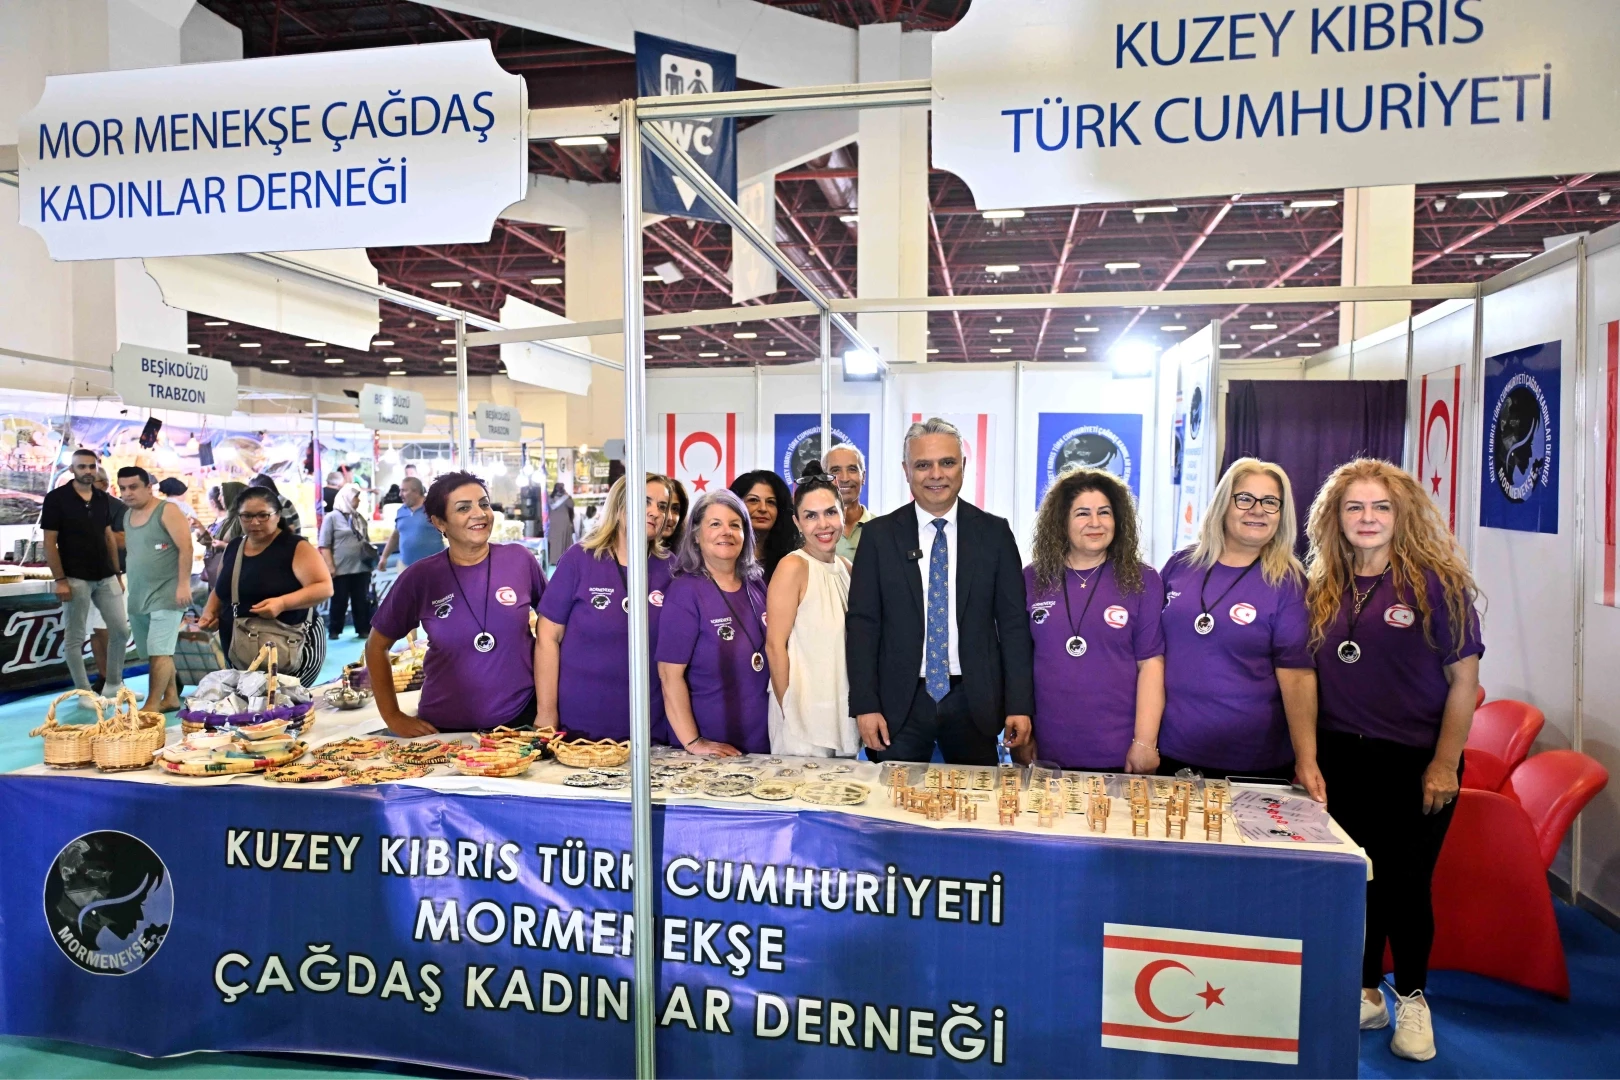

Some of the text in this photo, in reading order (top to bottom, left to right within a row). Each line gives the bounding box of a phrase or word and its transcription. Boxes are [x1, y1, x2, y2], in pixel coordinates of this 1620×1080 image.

[1115, 0, 1485, 69] KUZEY KIBRIS
[39, 88, 496, 161] MOR MENEKŞE ÇAĞDAŞ
[1000, 62, 1553, 153] TÜRK CUMHURİYETİ
[660, 120, 714, 156] WC
[40, 156, 408, 222] KADINLAR DERNEĞİ
[141, 357, 209, 382] BEŞİKDÜZÜ
[148, 383, 207, 405] TRABZON
[374, 393, 411, 409] BEDÜZÜ
[1497, 467, 1539, 500] MORMENEKŞE
[226, 829, 362, 871] KUZEY
[381, 837, 520, 882] KIBRIS
[666, 857, 1002, 924] CUMHURİYETİ
[57, 925, 152, 970] MORMENEKŞE
[214, 944, 1005, 1064] ÇAĞDAŞ KADINAR DERNEĞİ
